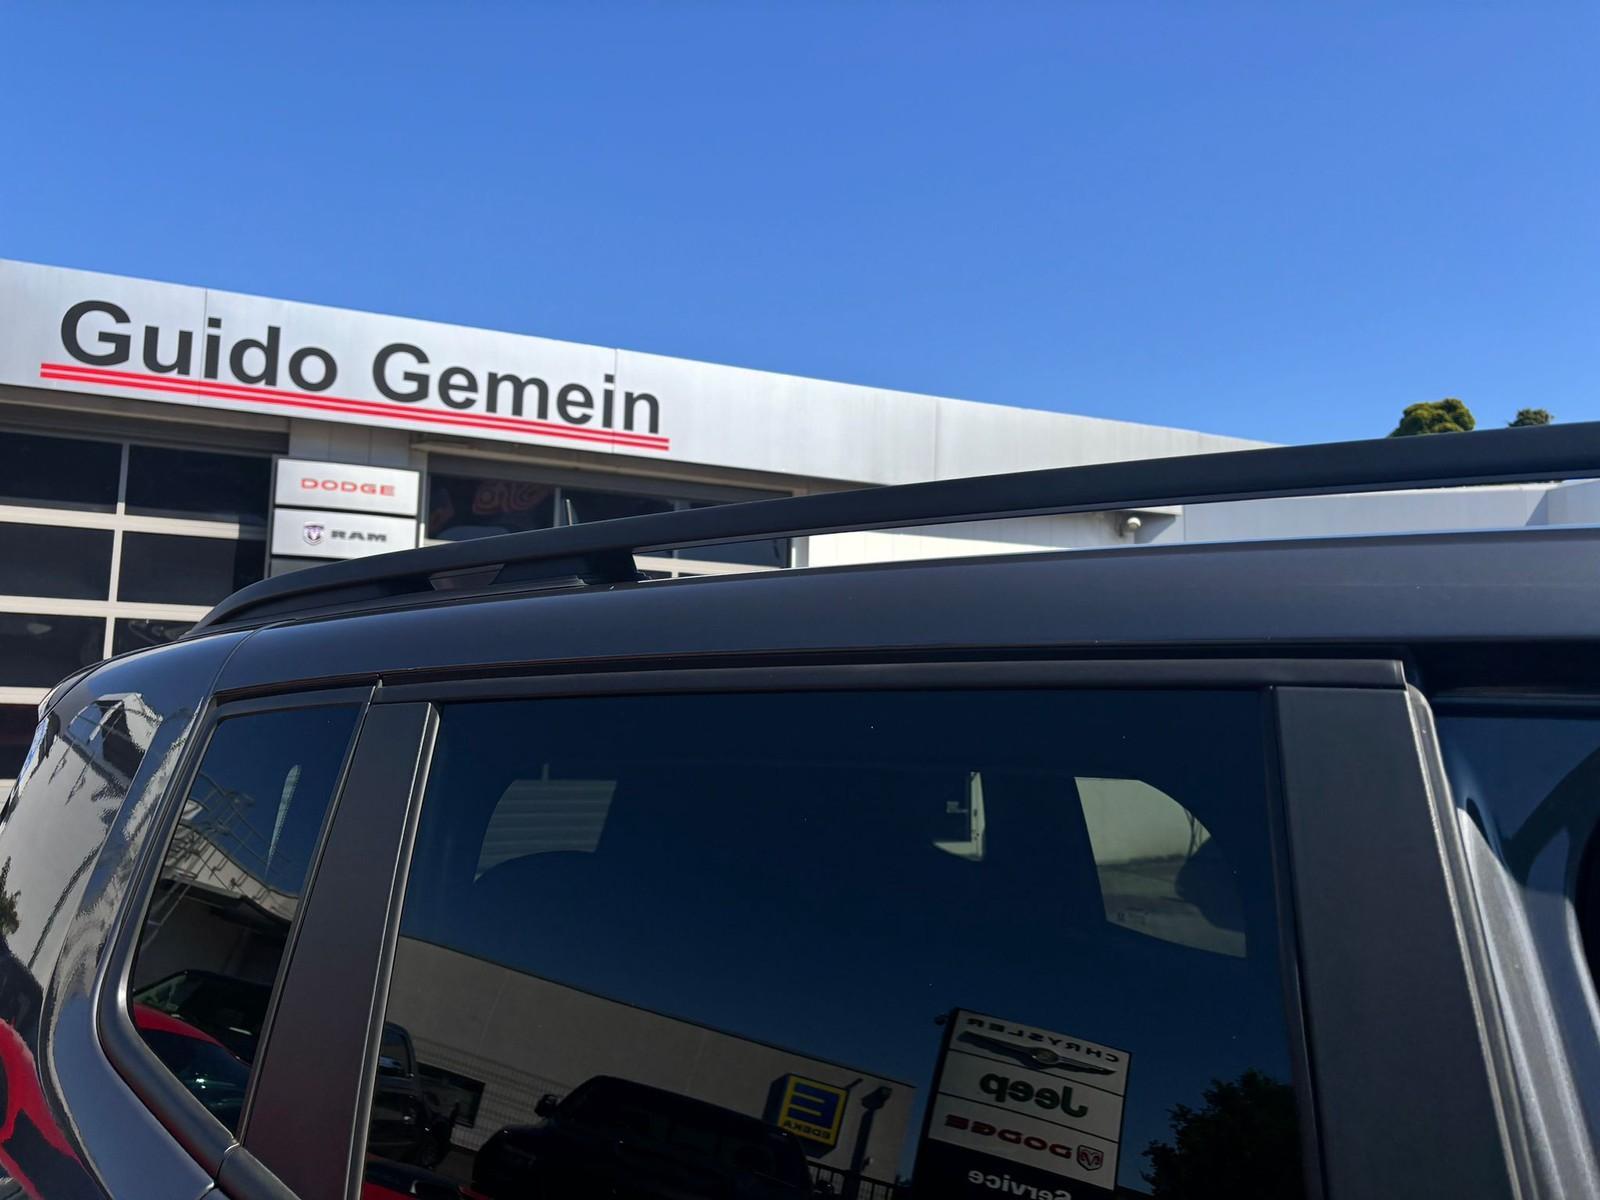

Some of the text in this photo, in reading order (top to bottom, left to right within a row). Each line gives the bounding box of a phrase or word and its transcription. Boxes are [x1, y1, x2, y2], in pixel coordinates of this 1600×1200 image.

[60, 300, 661, 434] Guido Gemein
[300, 478, 396, 497] DODGE
[331, 530, 387, 543] RAM
